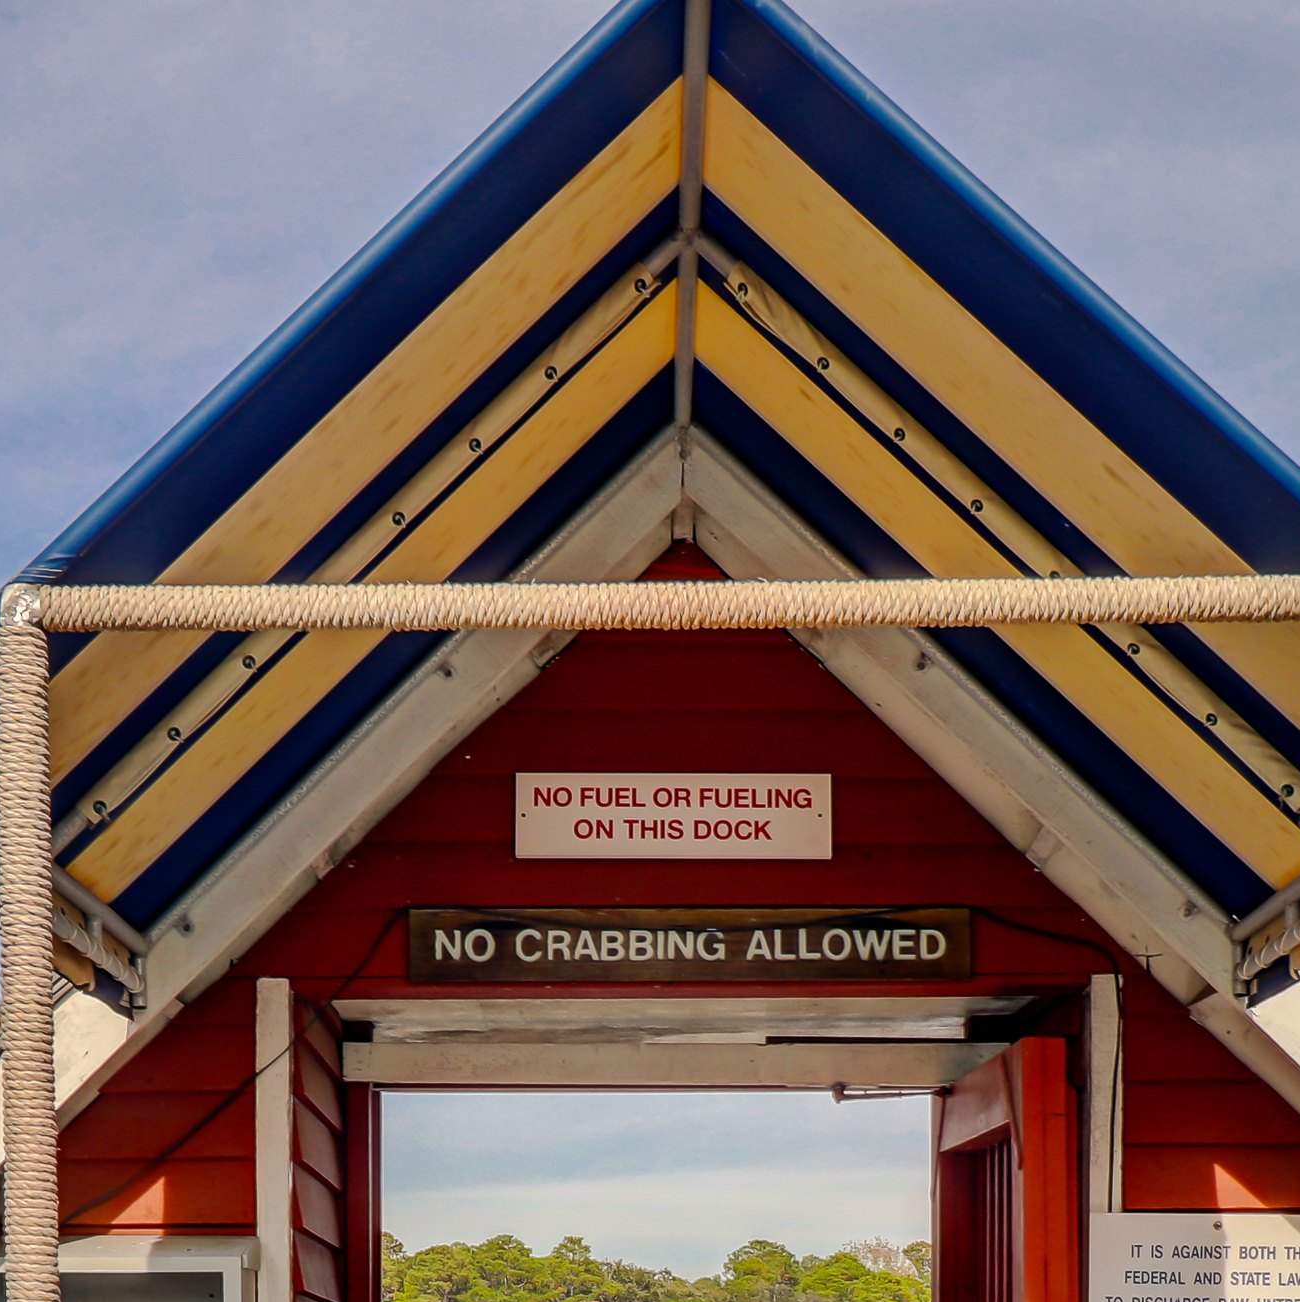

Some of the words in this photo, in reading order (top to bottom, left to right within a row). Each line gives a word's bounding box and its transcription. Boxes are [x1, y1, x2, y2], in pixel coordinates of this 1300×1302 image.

[533, 786, 572, 808] NO
[579, 787, 646, 808] FUEL
[652, 787, 692, 809] OR
[698, 787, 813, 809] FUELING
[573, 819, 615, 840] ON
[623, 819, 684, 841] THIS
[693, 819, 773, 841] DOCK
[434, 929, 495, 962] NO
[515, 928, 727, 962] CRABBING
[746, 928, 947, 961] ALLOWED
[1131, 1244, 1142, 1258] IT
[1151, 1245, 1163, 1258] IS
[1172, 1245, 1230, 1260] AGAINST
[1239, 1246, 1276, 1260] BOTH
[1125, 1271, 1185, 1284] FEDERAL
[1194, 1272, 1222, 1285] AND
[1230, 1272, 1270, 1286] STATE
